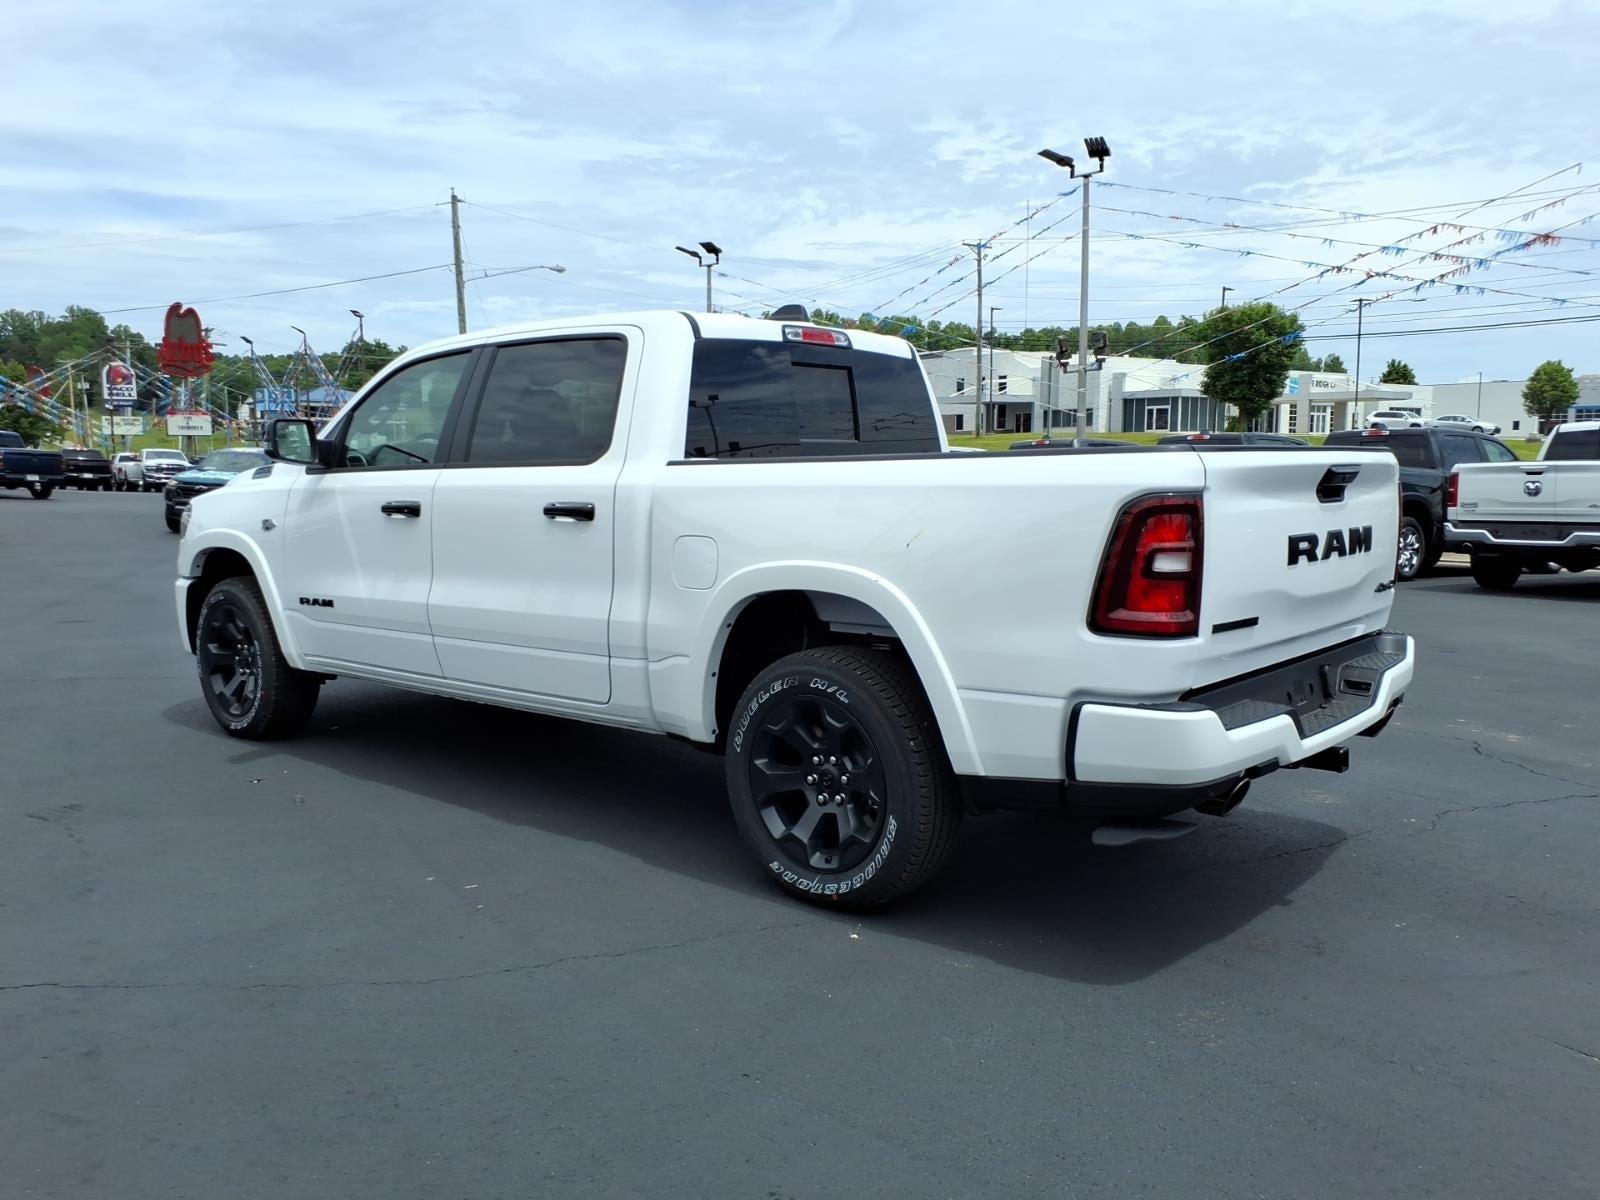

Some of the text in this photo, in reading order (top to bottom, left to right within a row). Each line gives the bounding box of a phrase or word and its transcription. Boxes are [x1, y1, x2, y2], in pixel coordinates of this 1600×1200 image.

[1287, 525, 1373, 566] RAM
[299, 597, 334, 608] RAM
[734, 676, 800, 752] DUELER
[769, 815, 898, 895] BRIDGESTONE
